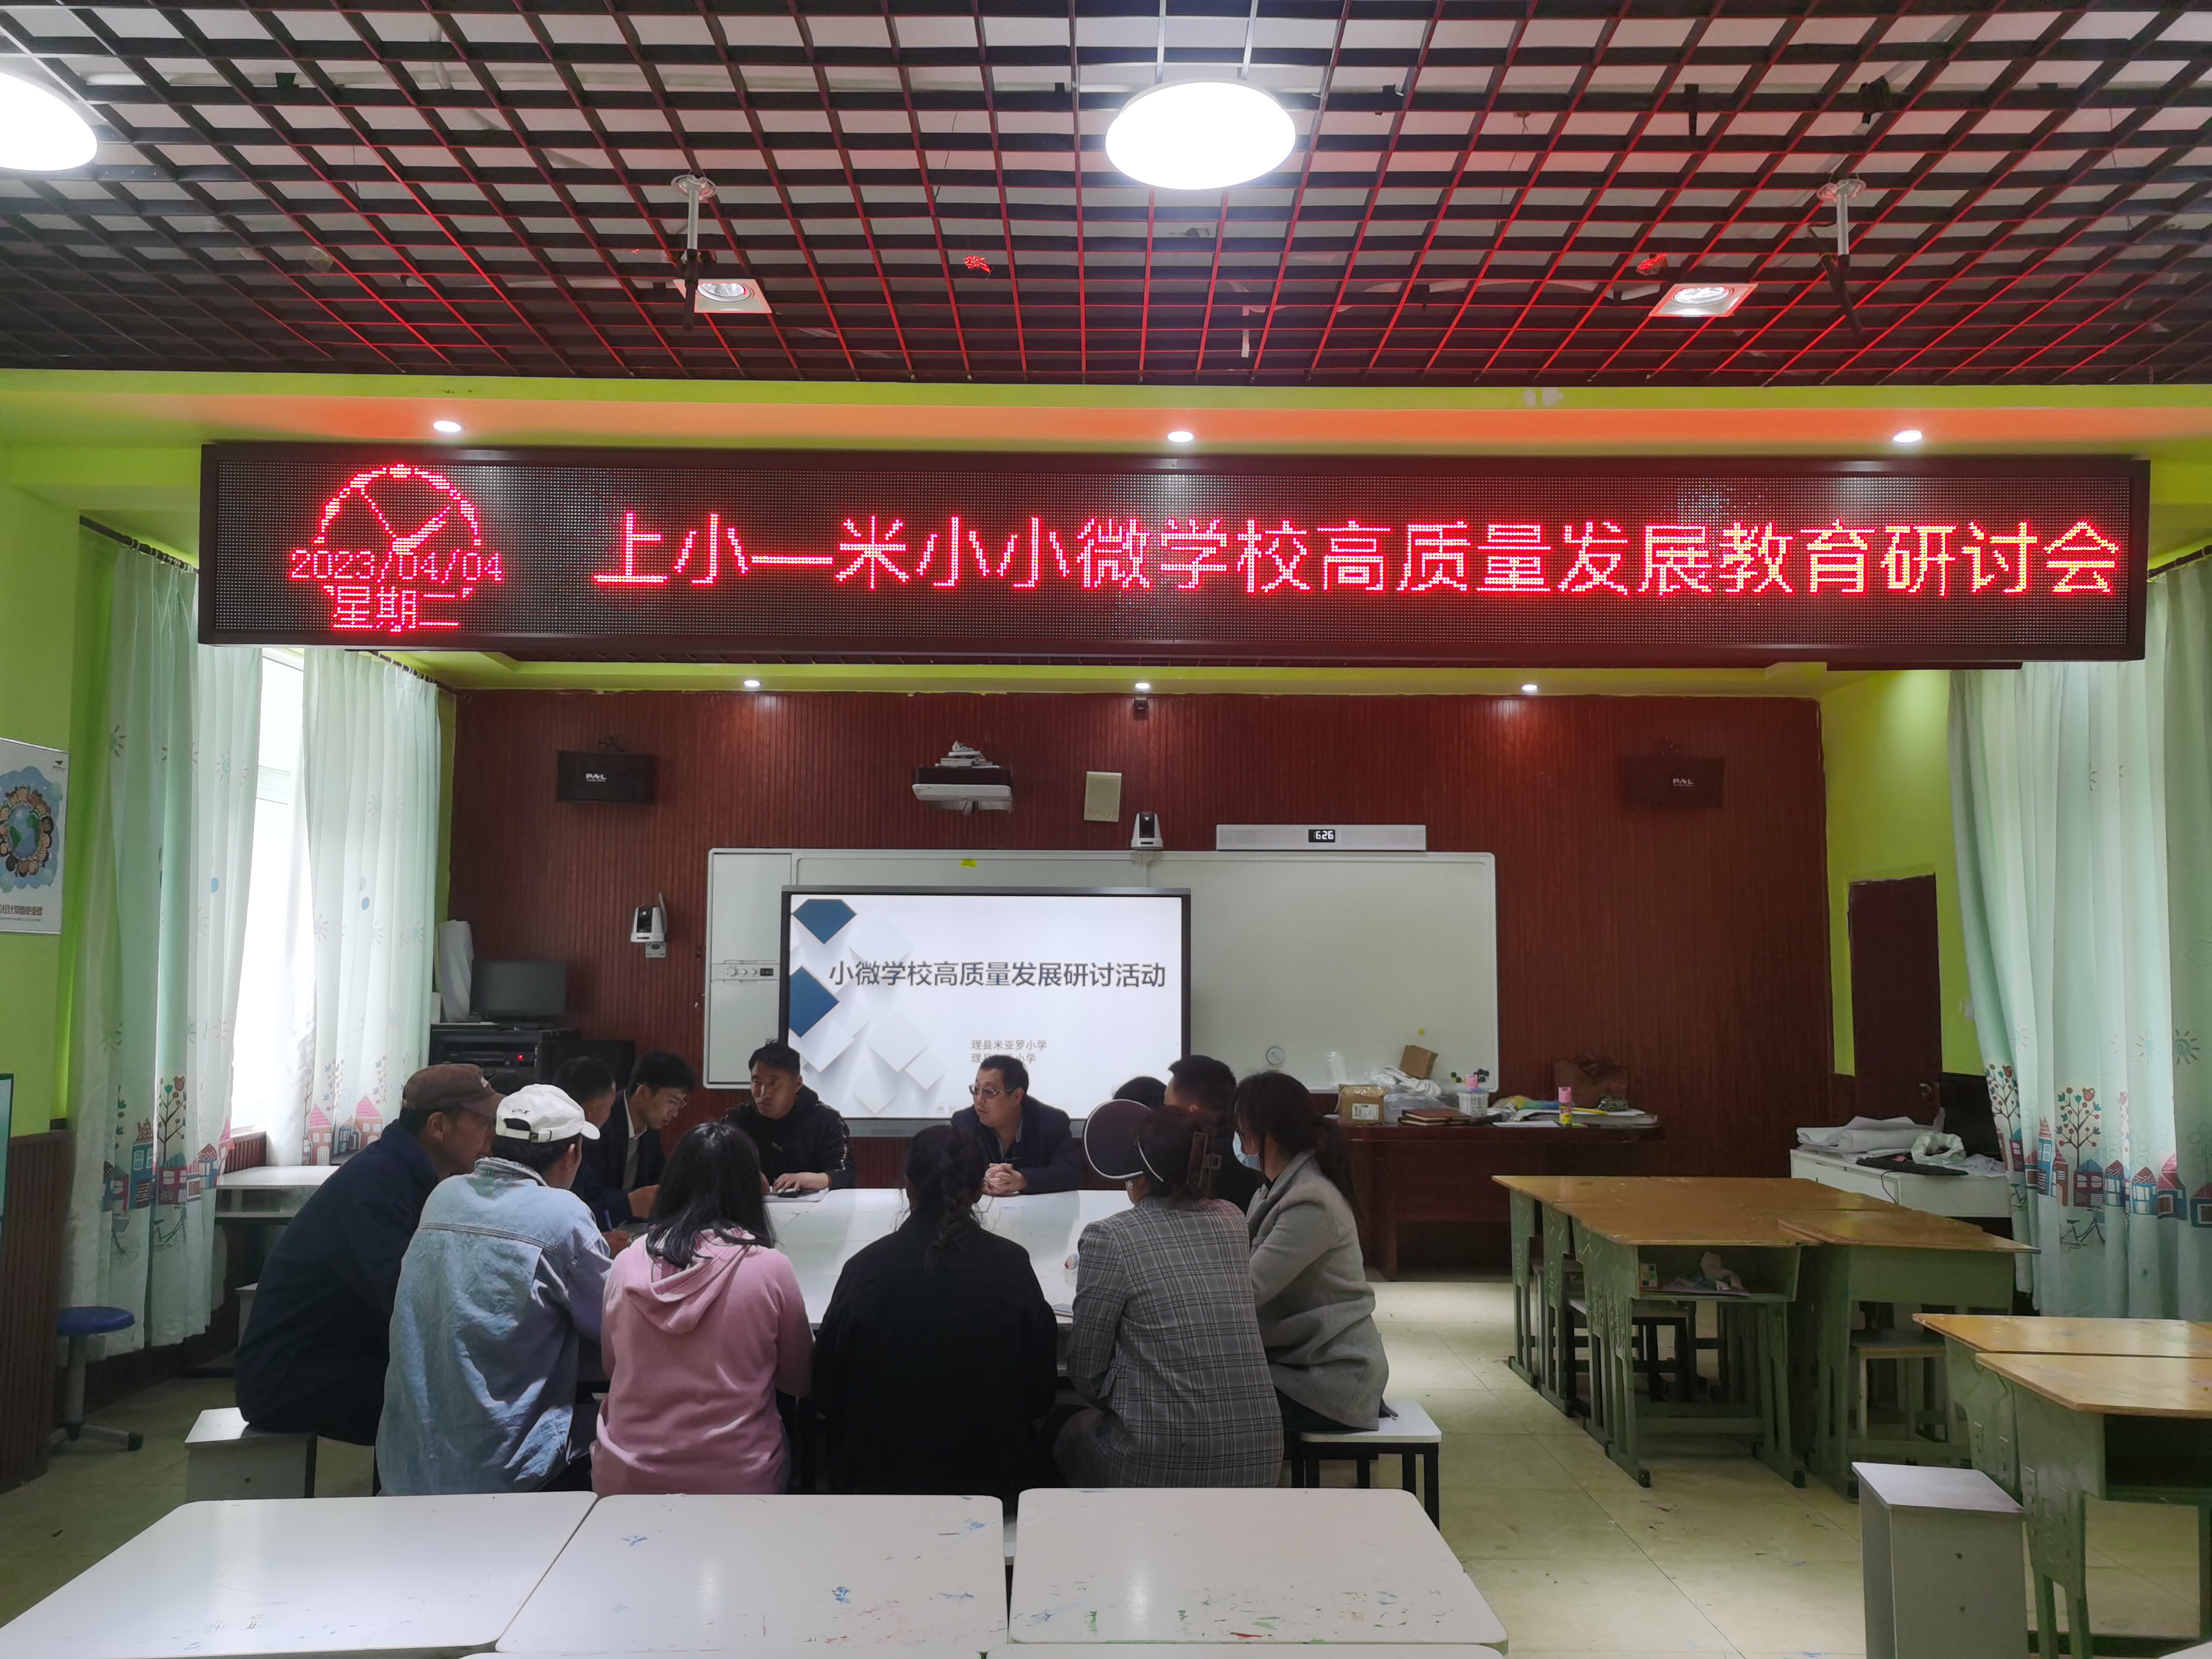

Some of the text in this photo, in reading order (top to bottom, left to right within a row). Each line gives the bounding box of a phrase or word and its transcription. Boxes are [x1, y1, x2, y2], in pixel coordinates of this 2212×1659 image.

[289, 548, 505, 582] 2023/04/04
[332, 585, 461, 632] 星期二
[829, 960, 1165, 987] 小微学校高质量发展研讨活动
[971, 1039, 1047, 1050] 理县米亚罗小学
[971, 1053, 1036, 1064] 理小学
